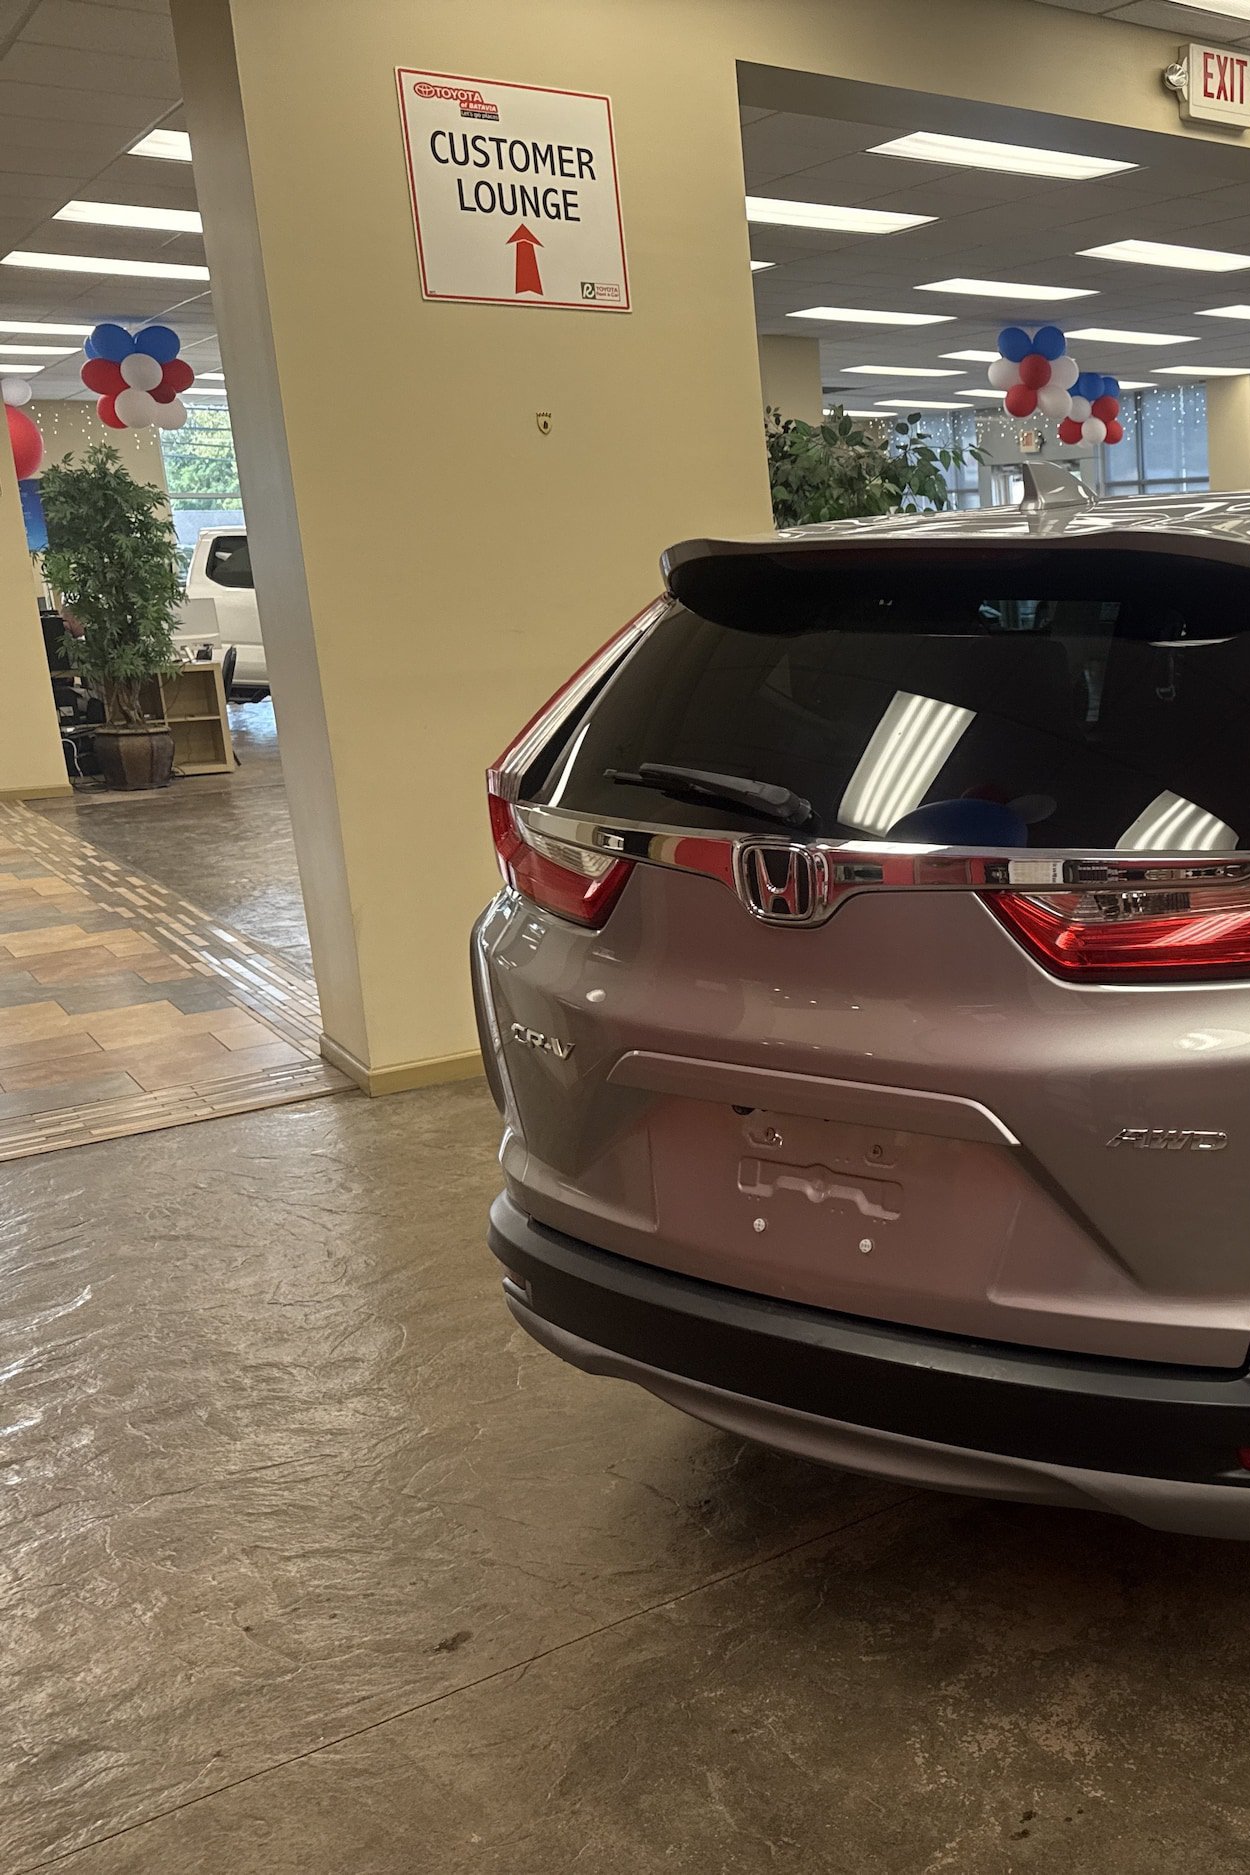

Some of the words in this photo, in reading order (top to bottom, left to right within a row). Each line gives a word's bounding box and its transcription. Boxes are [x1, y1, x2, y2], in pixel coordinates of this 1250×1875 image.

[434, 87, 482, 102] TOYOTA
[1203, 52, 1248, 104] EXIT
[469, 102, 497, 112] BATAVIA
[430, 130, 597, 180] CUSTOMER
[456, 178, 581, 222] LOUNGE
[510, 1022, 576, 1061] CR-V
[1106, 1128, 1228, 1151] AWD
